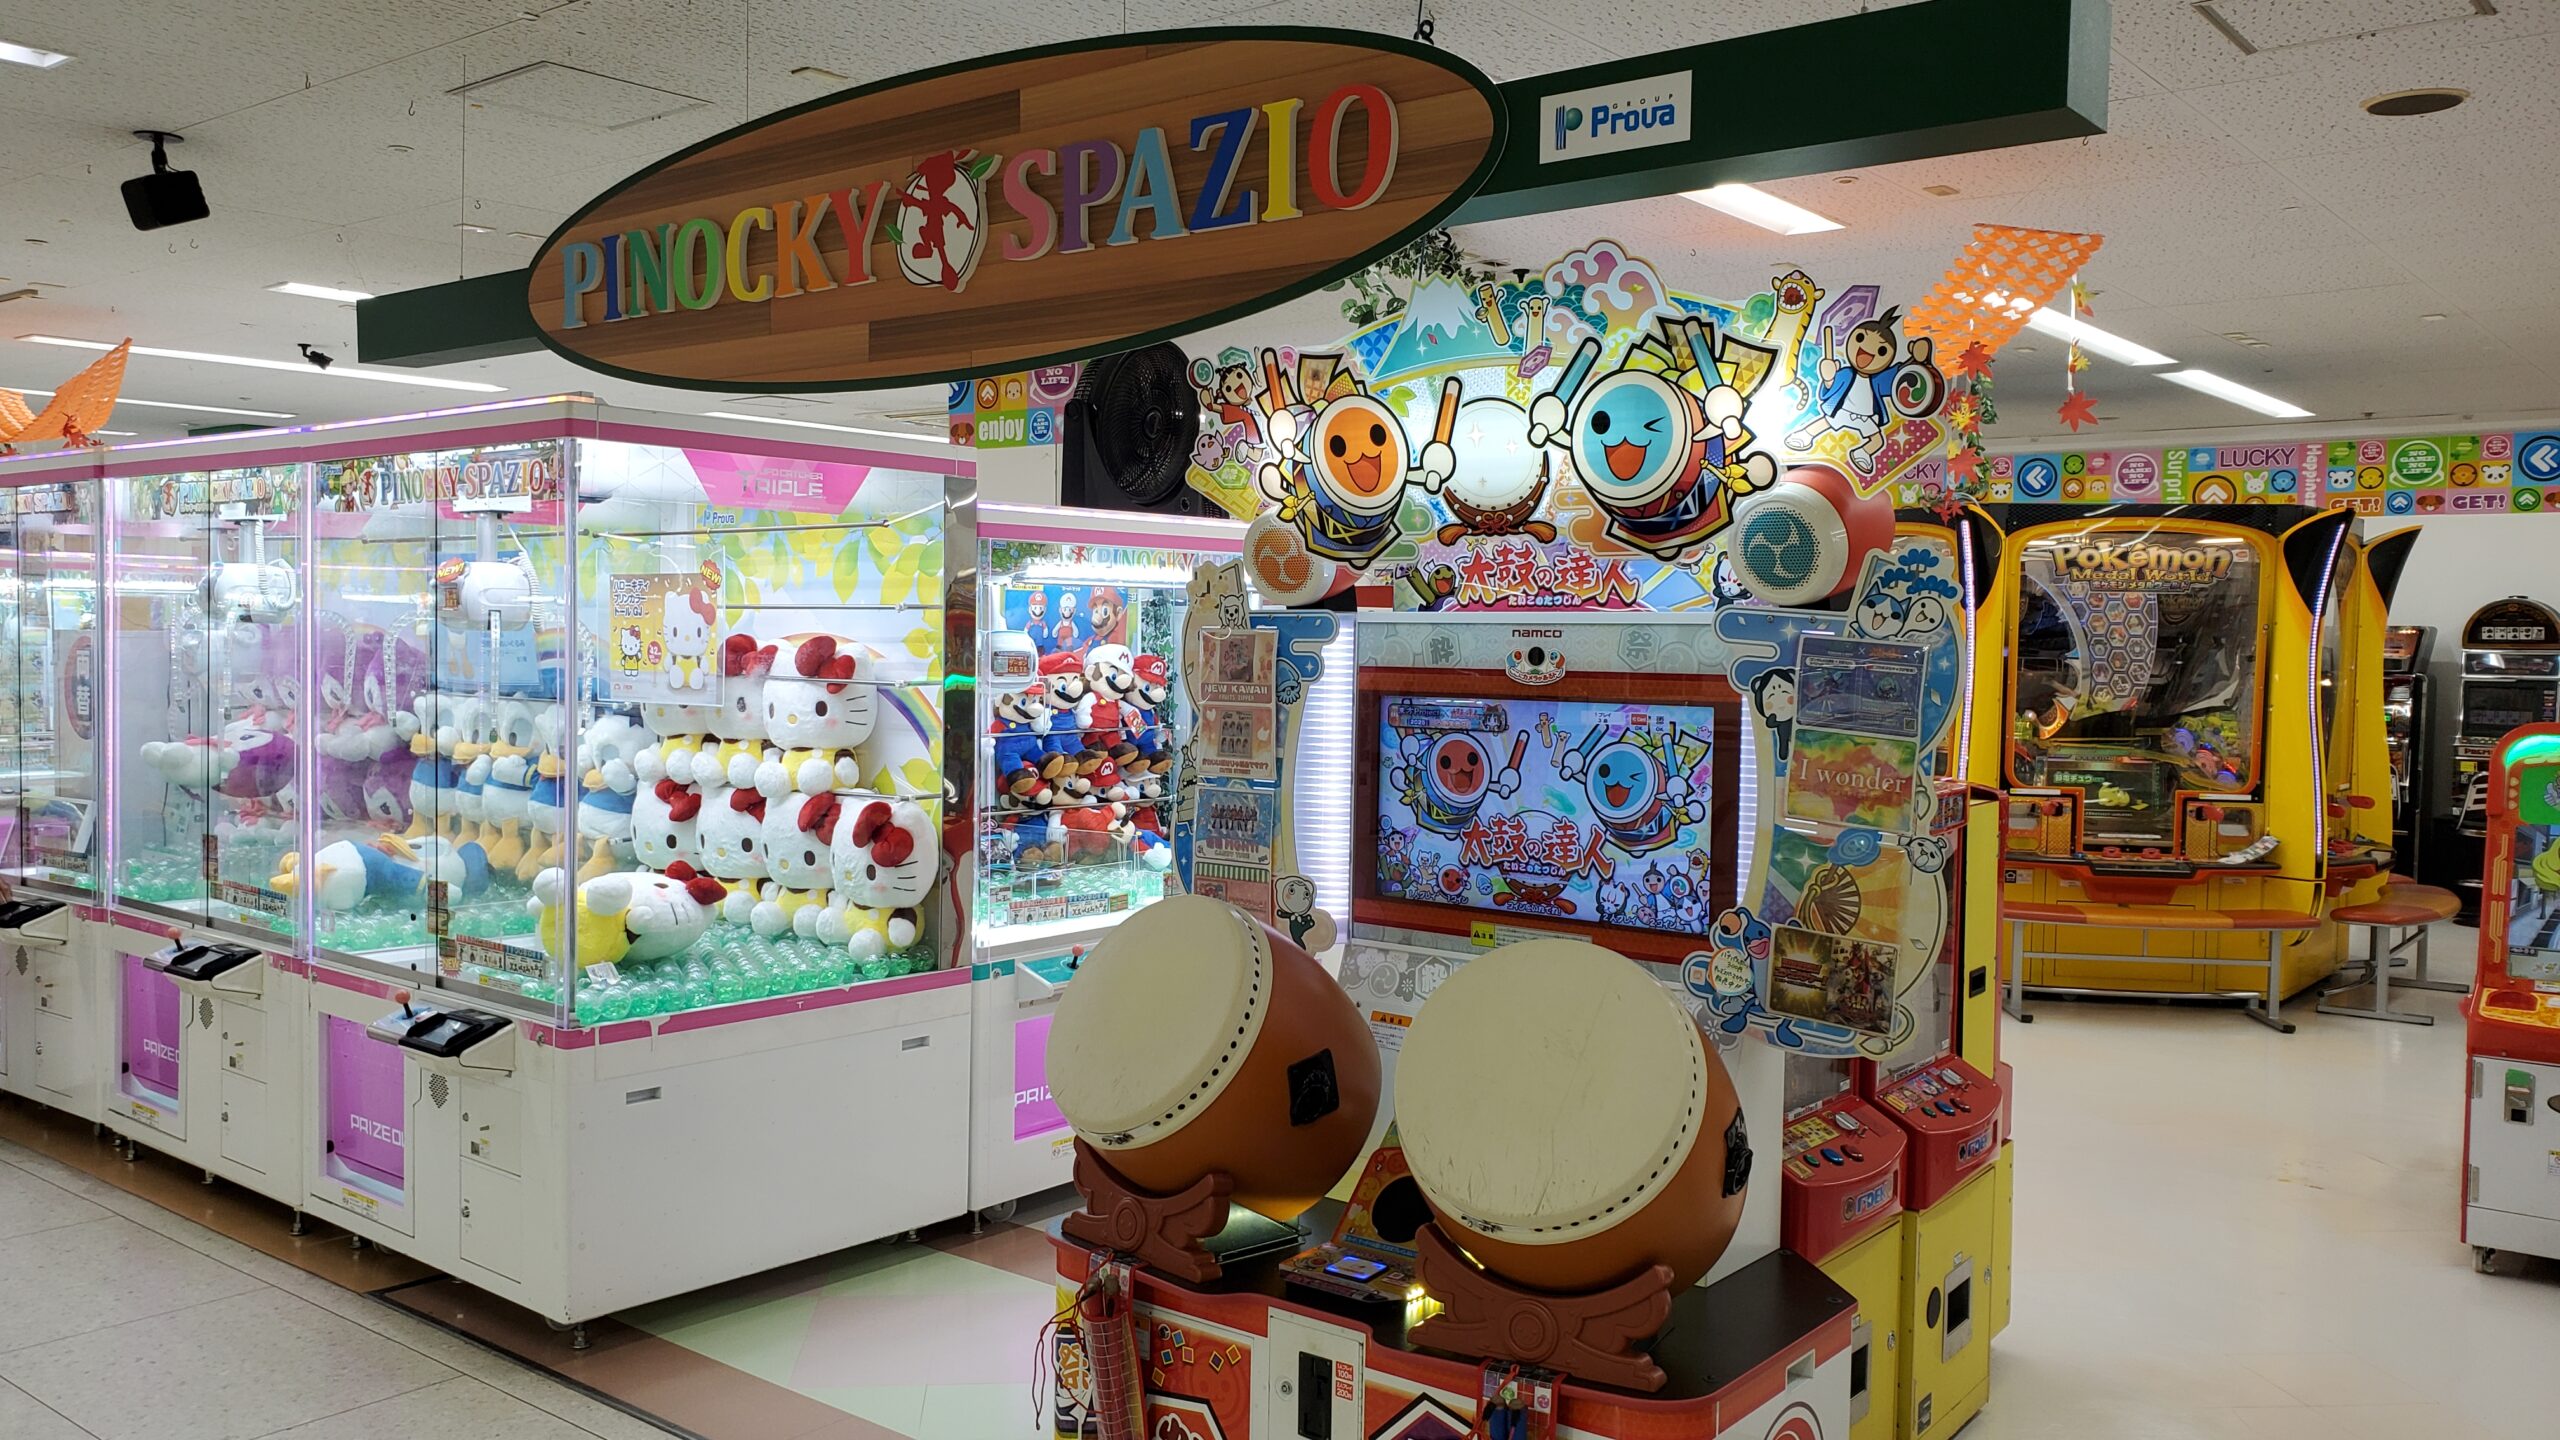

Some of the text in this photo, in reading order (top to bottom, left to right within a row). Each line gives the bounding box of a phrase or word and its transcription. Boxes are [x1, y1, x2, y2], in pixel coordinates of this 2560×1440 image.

[1612, 94, 1674, 110] GROUP
[1591, 103, 1675, 138] Prova
[561, 83, 1399, 330] PINOCKY SPAZIO
[1045, 368, 1063, 376] NO
[1041, 377, 1069, 385] LIFE
[979, 416, 1024, 441] enjoy
[2220, 448, 2295, 468] LUCKY
[1903, 463, 1941, 480] CKY
[380, 459, 544, 506] PINOCKY SPAZIO
[736, 470, 824, 498] TRIPLE
[179, 480, 231, 504] PINOCKY
[2452, 494, 2506, 511] GET!
[713, 512, 735, 524] Prova
[2051, 539, 2233, 578] Pokémon
[437, 561, 465, 578] NEW!
[700, 564, 722, 585] NEW!
[1458, 542, 1640, 606] 太鼓の達人
[2070, 567, 2213, 583] Medal World
[613, 579, 650, 592] ハローキティ
[2092, 580, 2126, 590] ポケモン
[613, 593, 648, 604] プリンカラー
[1507, 594, 1582, 607] たいこのたつじん
[614, 606, 643, 617] トール GJ
[1512, 629, 1563, 638] namco
[1205, 684, 1267, 695] NEW KAWAII
[1800, 759, 1906, 793] I wonder
[1460, 813, 1615, 879] 太鼓の達人
[1503, 861, 1566, 877] たいこのたつじん
[1649, 918, 1677, 930] 2コイン
[1337, 1369, 1353, 1381] 100円
[1336, 1388, 1353, 1400] 200円
